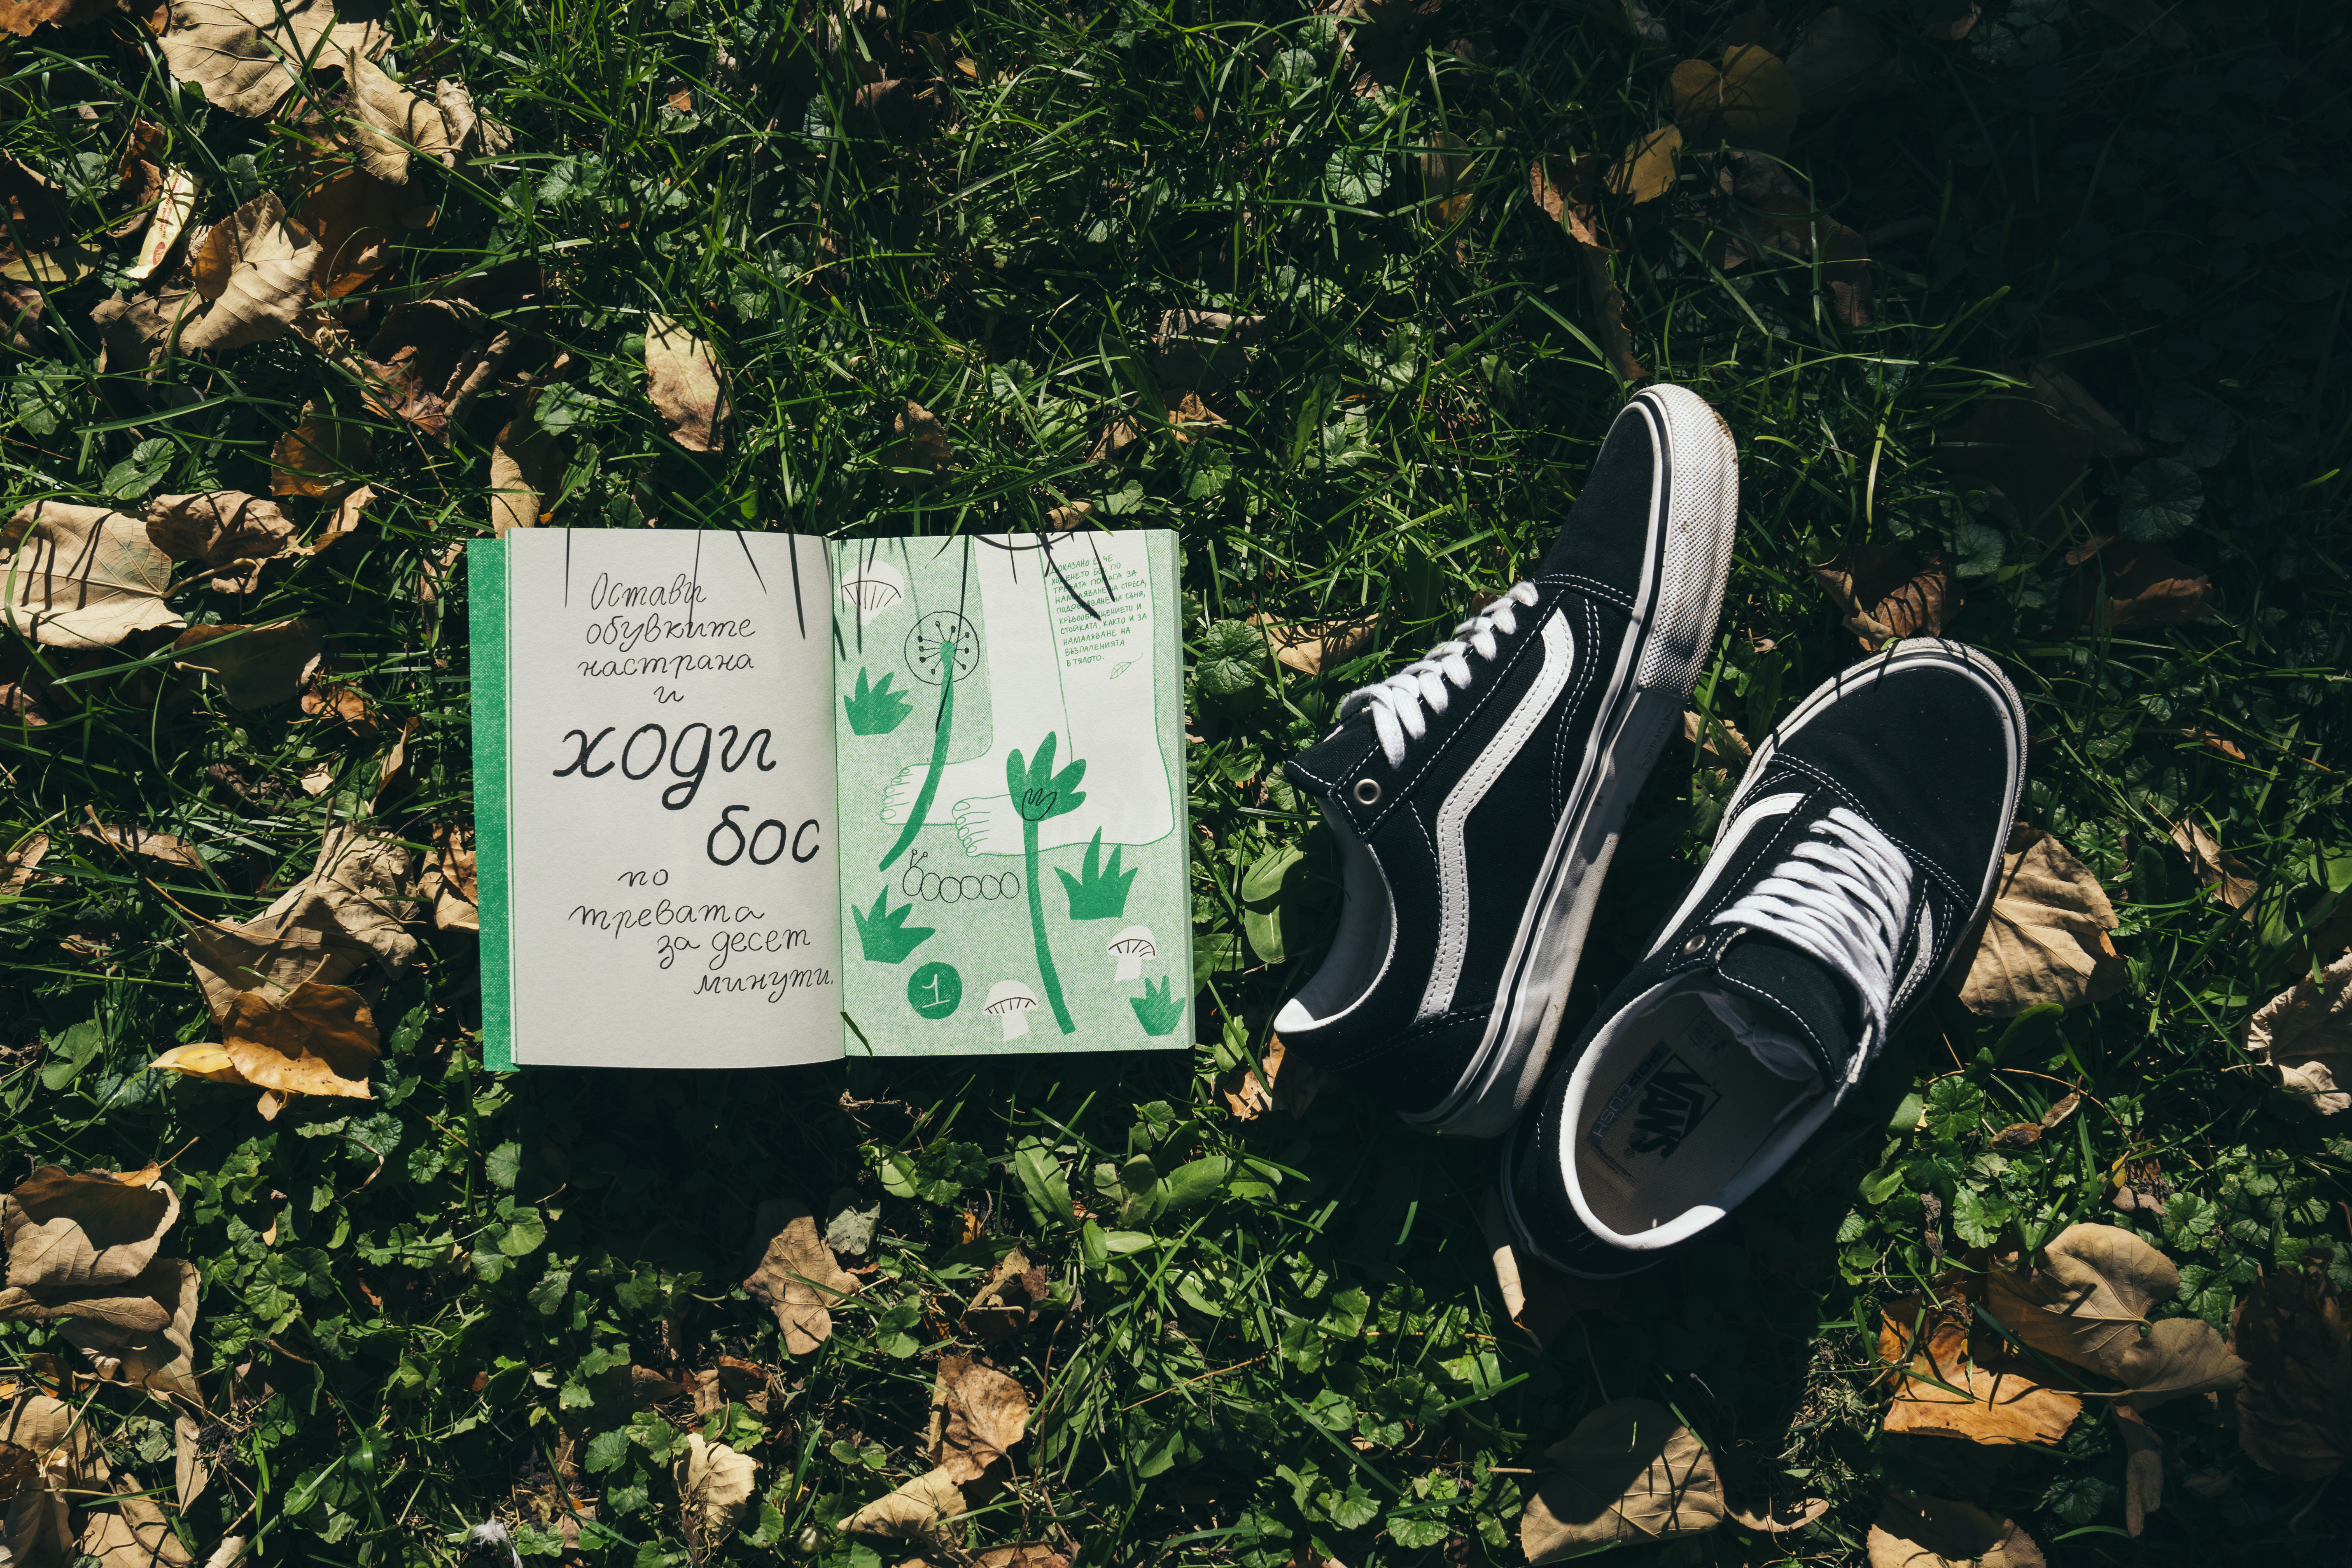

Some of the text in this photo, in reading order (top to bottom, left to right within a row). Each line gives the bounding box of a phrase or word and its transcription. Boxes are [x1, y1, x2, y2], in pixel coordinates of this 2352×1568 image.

[1049, 559, 1090, 576] ДОКАЗАНО
[1052, 562, 1121, 585] ХОДЕНЕТО БОС ПО
[591, 572, 706, 609] Остави
[1053, 581, 1086, 594] ТРЕВАТА
[1091, 574, 1122, 585] ПОМАГА
[1055, 586, 1107, 604] НАМАЛЯВАНЕ
[1121, 579, 1147, 589] СТРЕСА,
[1057, 597, 1113, 614] ПОДОБРЯВАНЕ
[1126, 591, 1145, 599] СЪНЯ,
[1059, 605, 1133, 625] КРЪВООБРАЩЕНИЕТО
[587, 613, 755, 651] обувките
[1061, 623, 1101, 634] СТОЙКАТА,
[1104, 617, 1125, 626] КАКТО
[1064, 630, 1117, 646] НАМАЛЯВАНЕ
[1065, 639, 1125, 656] ВЪЗПАЛЕНИЯТА
[578, 654, 754, 679] настрана
[653, 686, 684, 703] и
[1644, 715, 1671, 758] DURACAP
[553, 723, 776, 810] ходи
[707, 805, 819, 866] бос
[618, 869, 668, 887] по
[569, 900, 764, 939] тревата
[658, 929, 810, 970] за десет
[694, 968, 833, 1003] минути.
[922, 974, 950, 1008] 1
[1630, 1071, 1706, 1157] VANS
